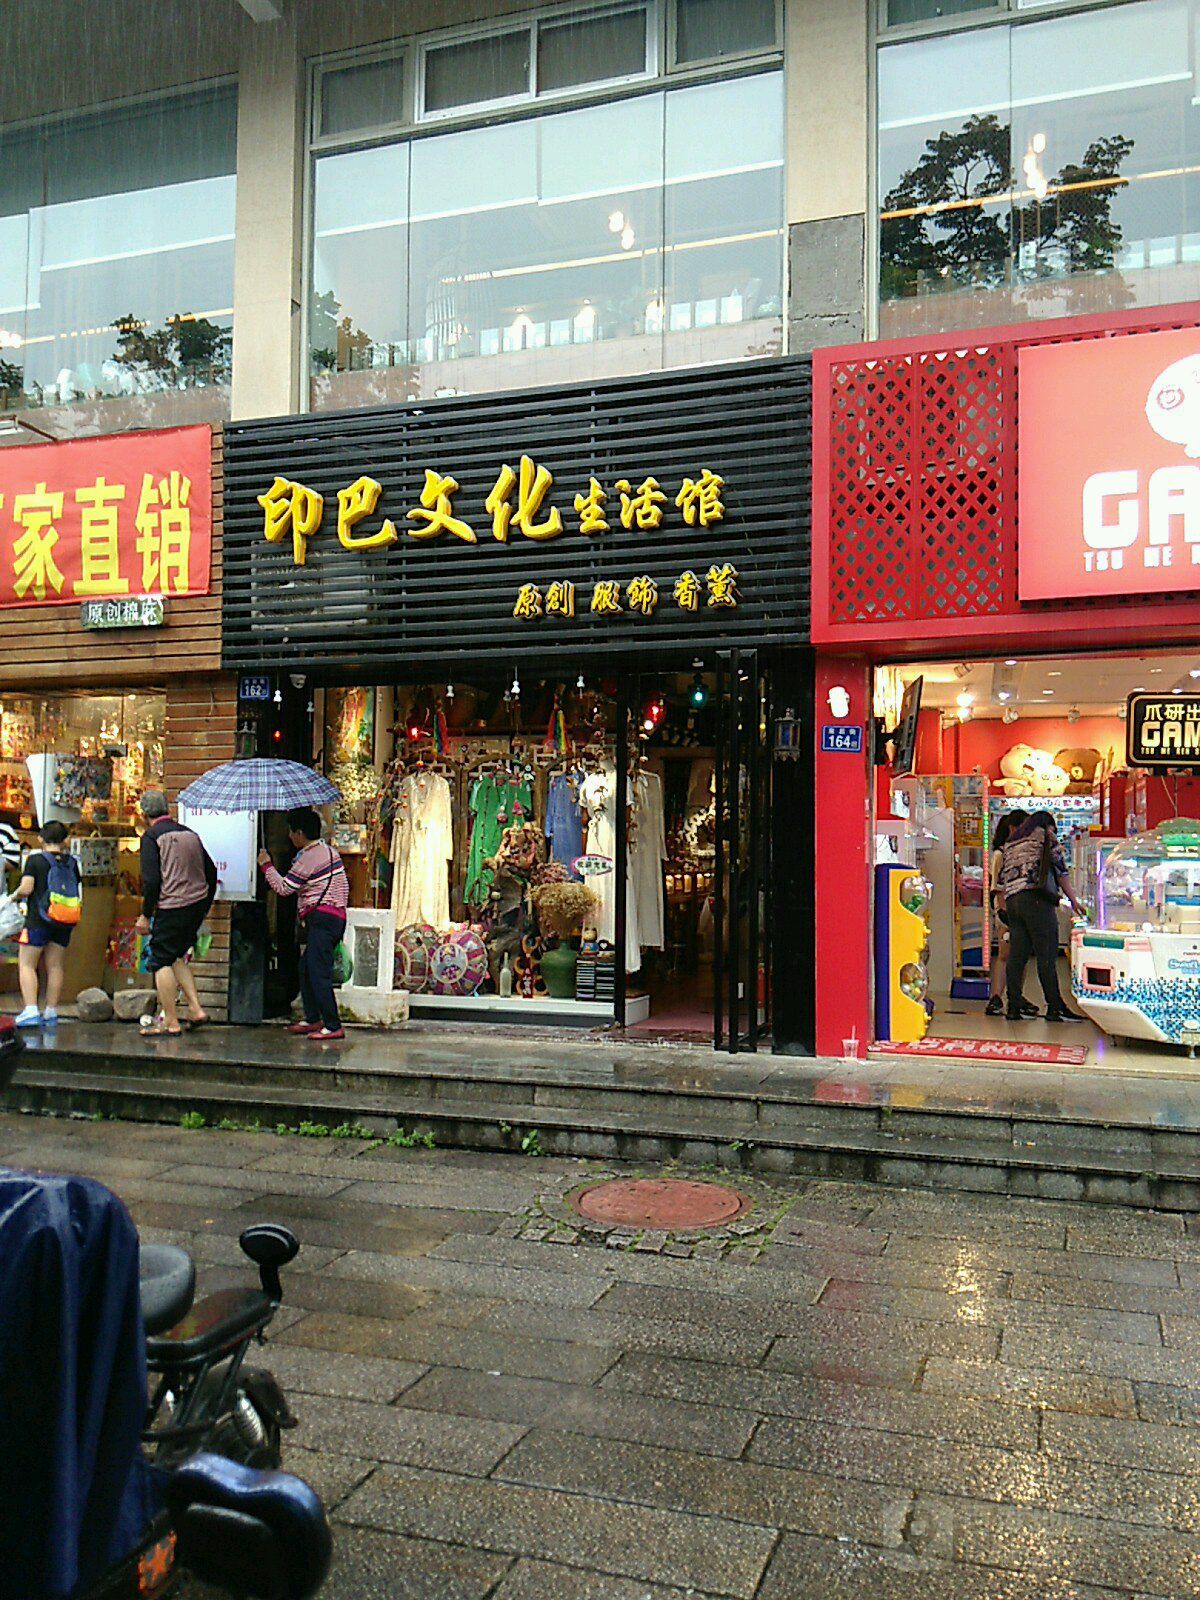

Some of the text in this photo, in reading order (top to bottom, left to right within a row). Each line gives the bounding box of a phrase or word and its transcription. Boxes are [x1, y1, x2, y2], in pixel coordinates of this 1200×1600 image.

[257, 454, 727, 565] 印巴文化生活馆
[0, 470, 192, 600] 家直销
[1083, 549, 1124, 572] TSU
[1143, 546, 1173, 568] ME
[245, 685, 266, 696] 162
[828, 734, 857, 748] 164
